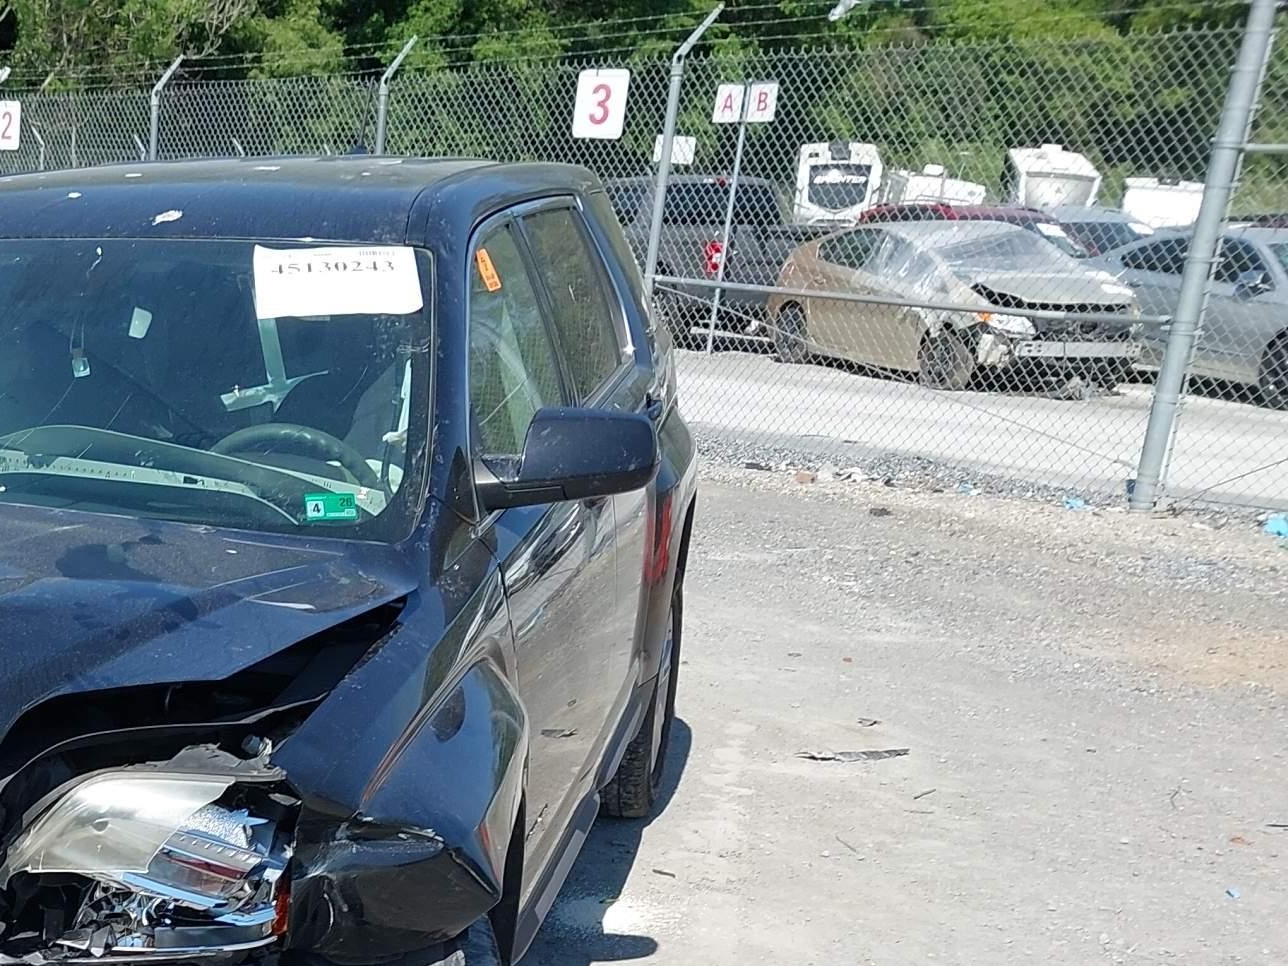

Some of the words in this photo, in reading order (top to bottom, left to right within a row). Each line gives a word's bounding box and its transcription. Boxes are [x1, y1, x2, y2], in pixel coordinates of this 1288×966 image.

[589, 83, 611, 125] 3
[721, 92, 733, 113] A
[756, 91, 769, 112] B
[1, 111, 12, 140] 2
[270, 260, 396, 275] 45130243
[312, 502, 322, 514] 4
